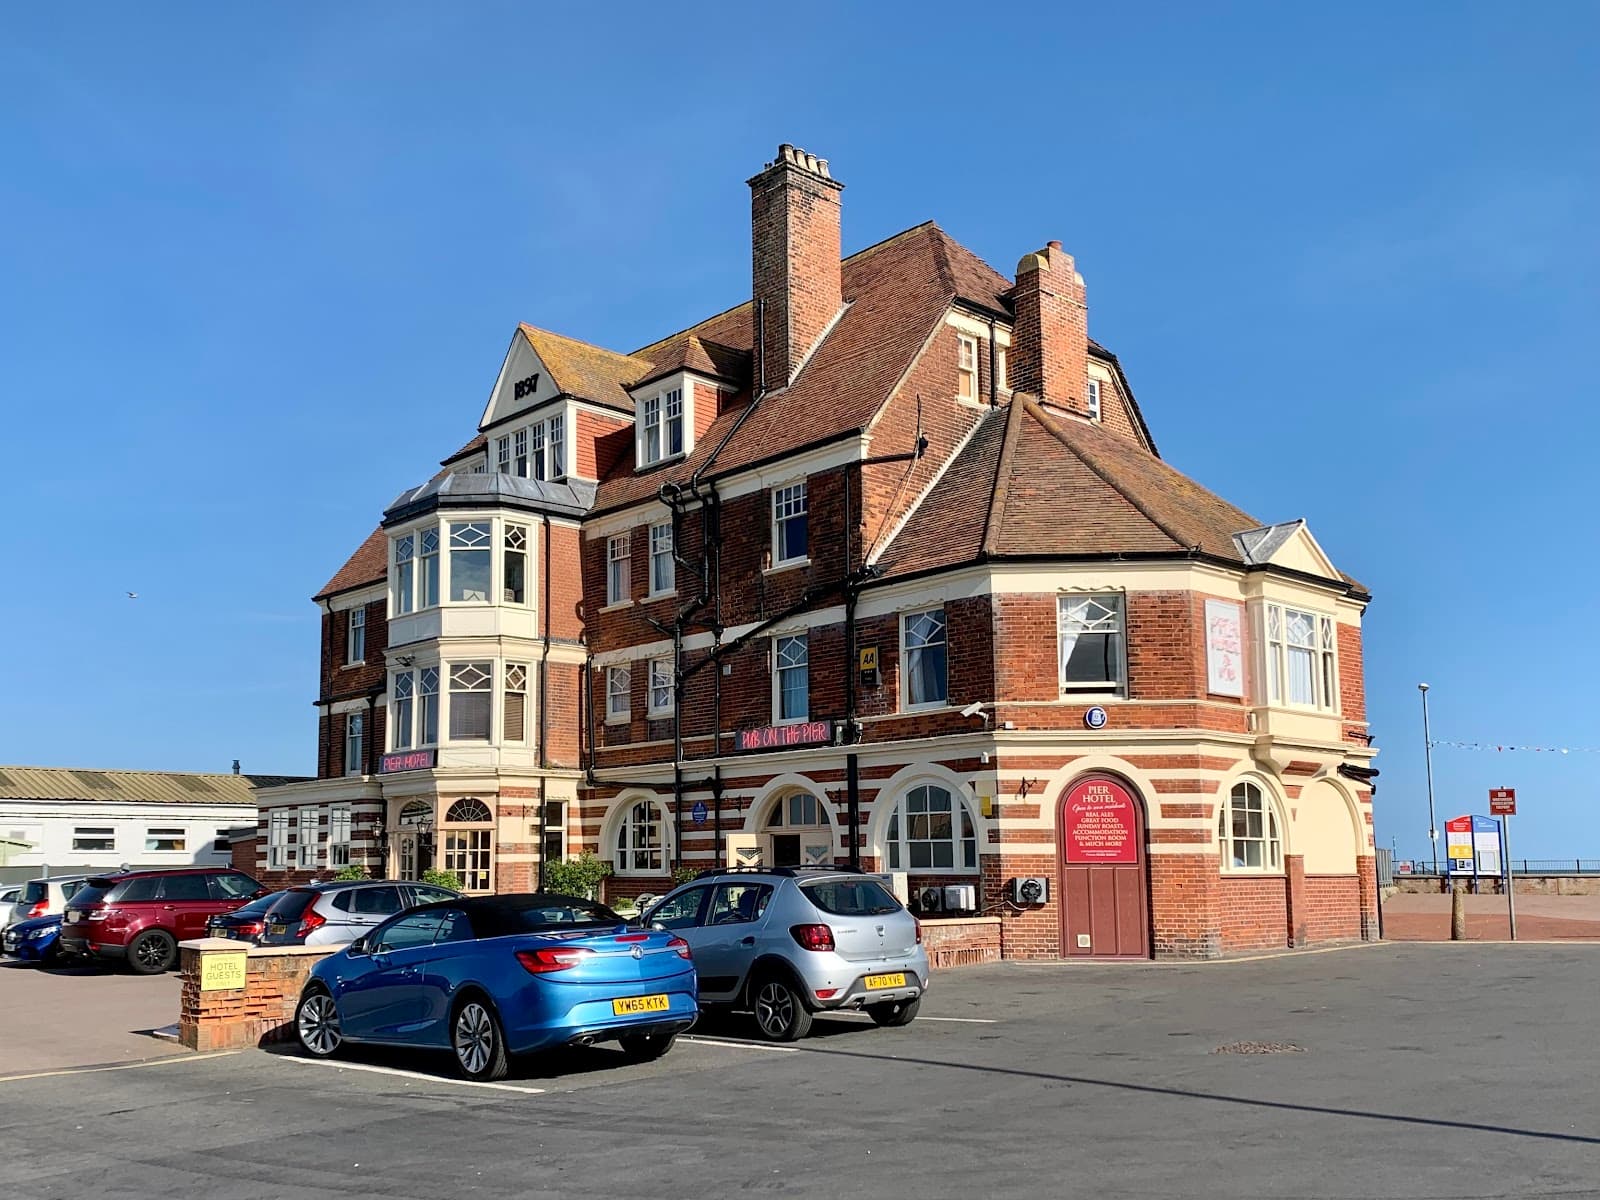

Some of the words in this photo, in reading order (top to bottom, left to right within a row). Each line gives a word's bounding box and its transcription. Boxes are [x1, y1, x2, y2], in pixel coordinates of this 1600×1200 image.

[514, 373, 540, 401] 1897
[863, 653, 875, 665] AA
[742, 730, 761, 749] PUB
[763, 727, 778, 746] ON
[780, 725, 800, 745] THE
[802, 722, 827, 742] PIER
[383, 756, 402, 771] PIER
[1088, 786, 1109, 794] PIER
[1072, 803, 1086, 813] Open
[210, 962, 239, 971] HOTEL
[206, 971, 242, 980] GUESTS
[618, 999, 645, 1012] YW65
[646, 996, 666, 1009] KTK
